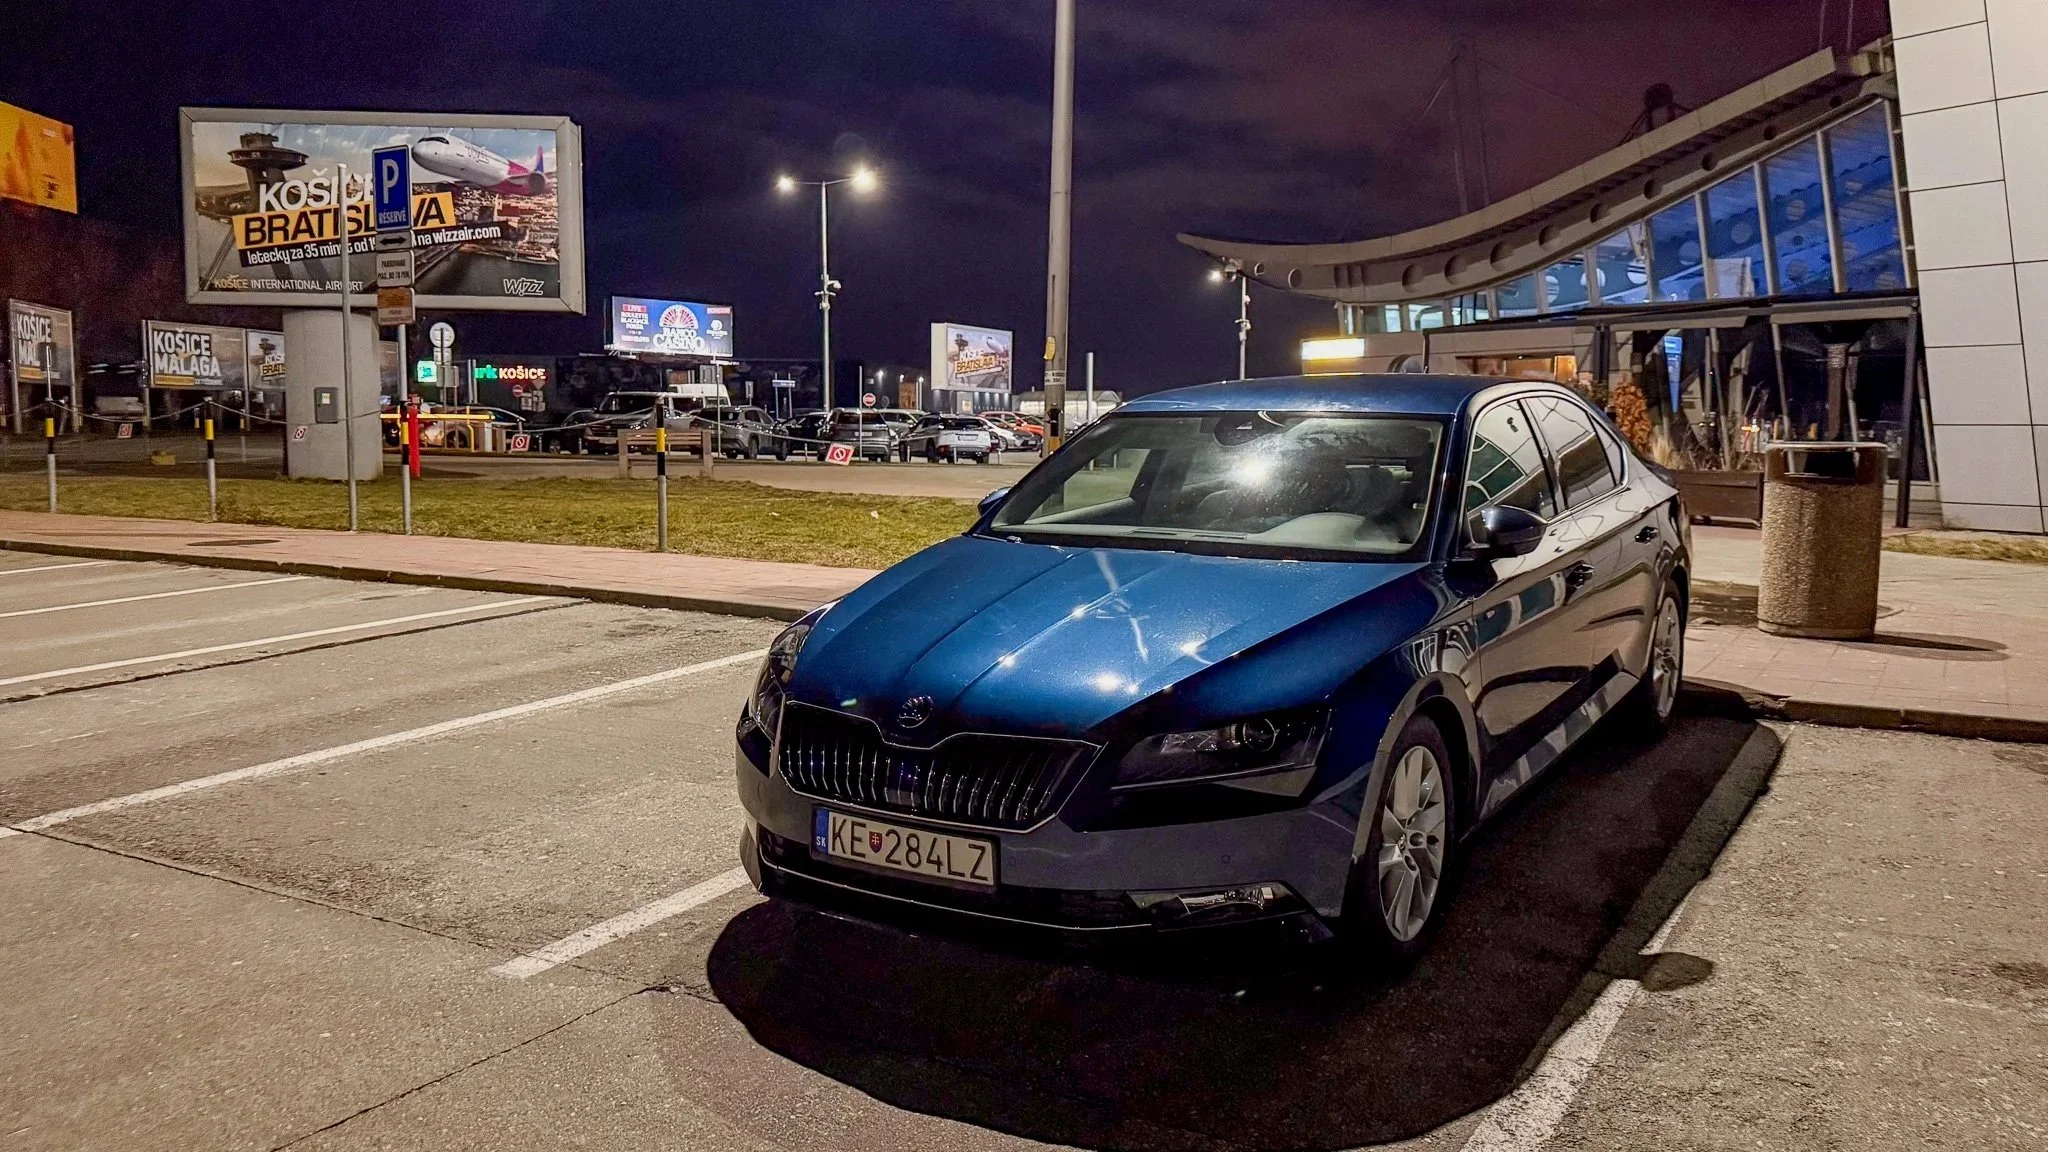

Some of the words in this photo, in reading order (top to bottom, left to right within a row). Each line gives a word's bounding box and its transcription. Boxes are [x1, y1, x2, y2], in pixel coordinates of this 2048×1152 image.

[382, 158, 400, 204] P
[247, 247, 291, 265] letecky
[290, 248, 305, 260] za
[304, 243, 319, 258] 35
[320, 241, 354, 257] mint
[354, 237, 368, 253] od
[417, 233, 432, 246] na
[433, 226, 502, 244] wizzair.com
[214, 274, 249, 290] KOŠICE
[251, 279, 324, 291] INTERNATIONAL
[325, 280, 364, 292] AIRORT
[16, 309, 52, 343] KOŠICE
[153, 327, 211, 356] KOŠICE
[653, 334, 706, 352] CASINO
[154, 352, 222, 377] MALAGA
[498, 365, 547, 380] KOŠICE
[815, 835, 827, 848] SK
[831, 816, 867, 859] KE
[884, 828, 989, 882] 284LZ
